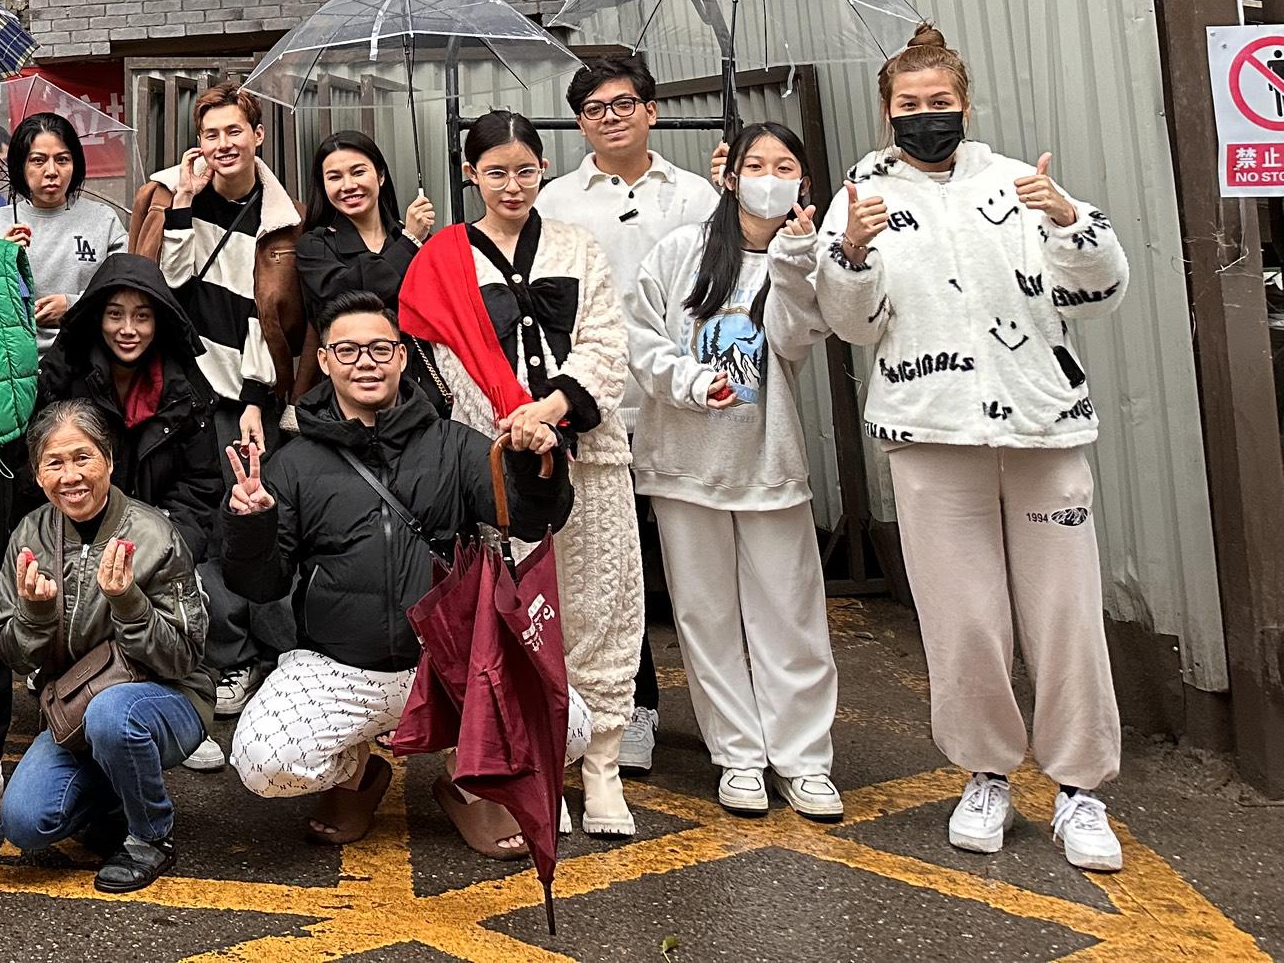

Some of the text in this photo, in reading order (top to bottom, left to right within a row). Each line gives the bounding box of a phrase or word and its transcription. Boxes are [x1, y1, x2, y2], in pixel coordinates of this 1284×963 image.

[1235, 147, 1283, 168] 禁止
[1236, 172, 1259, 183] NO
[74, 235, 97, 262] LA
[1026, 512, 1049, 523] 1994
